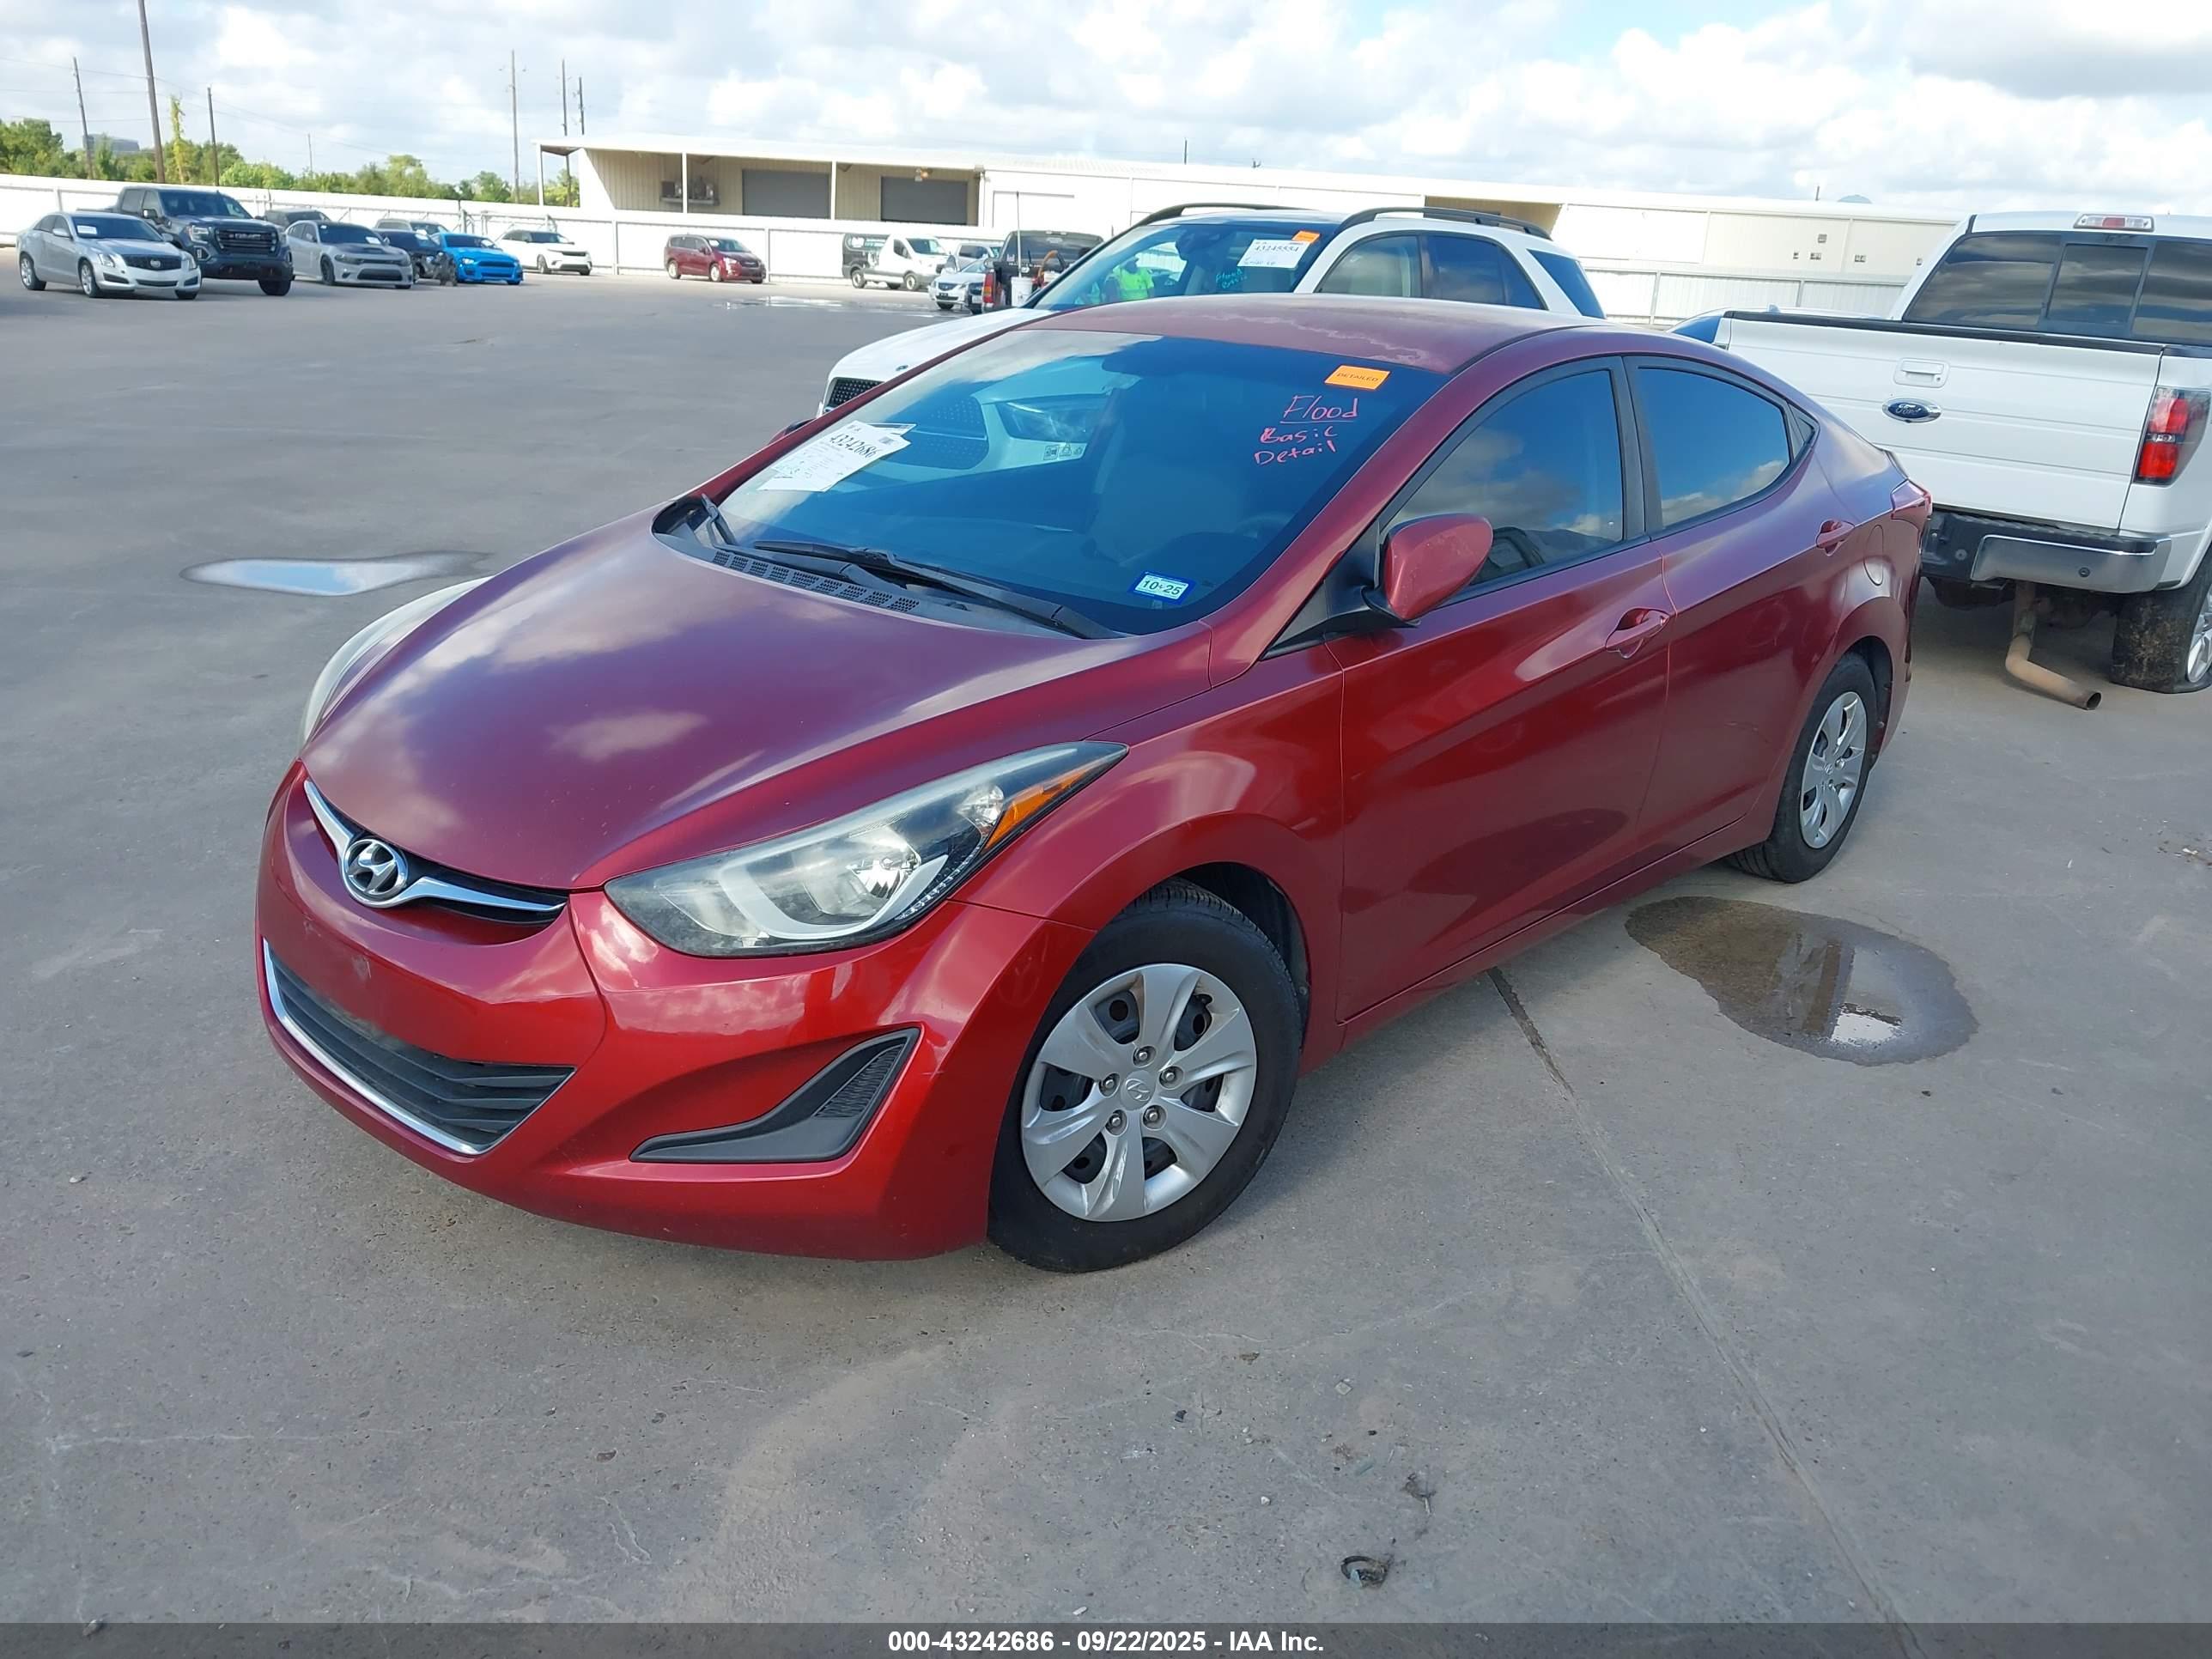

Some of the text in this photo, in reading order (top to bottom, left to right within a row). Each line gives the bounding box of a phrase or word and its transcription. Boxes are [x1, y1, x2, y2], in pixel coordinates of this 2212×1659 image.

[1336, 373, 1379, 382] DETAILED
[1282, 395, 1359, 421] Flood
[829, 433, 881, 459] 43242686
[1260, 425, 1338, 445] Basic
[1254, 440, 1337, 466] Detail
